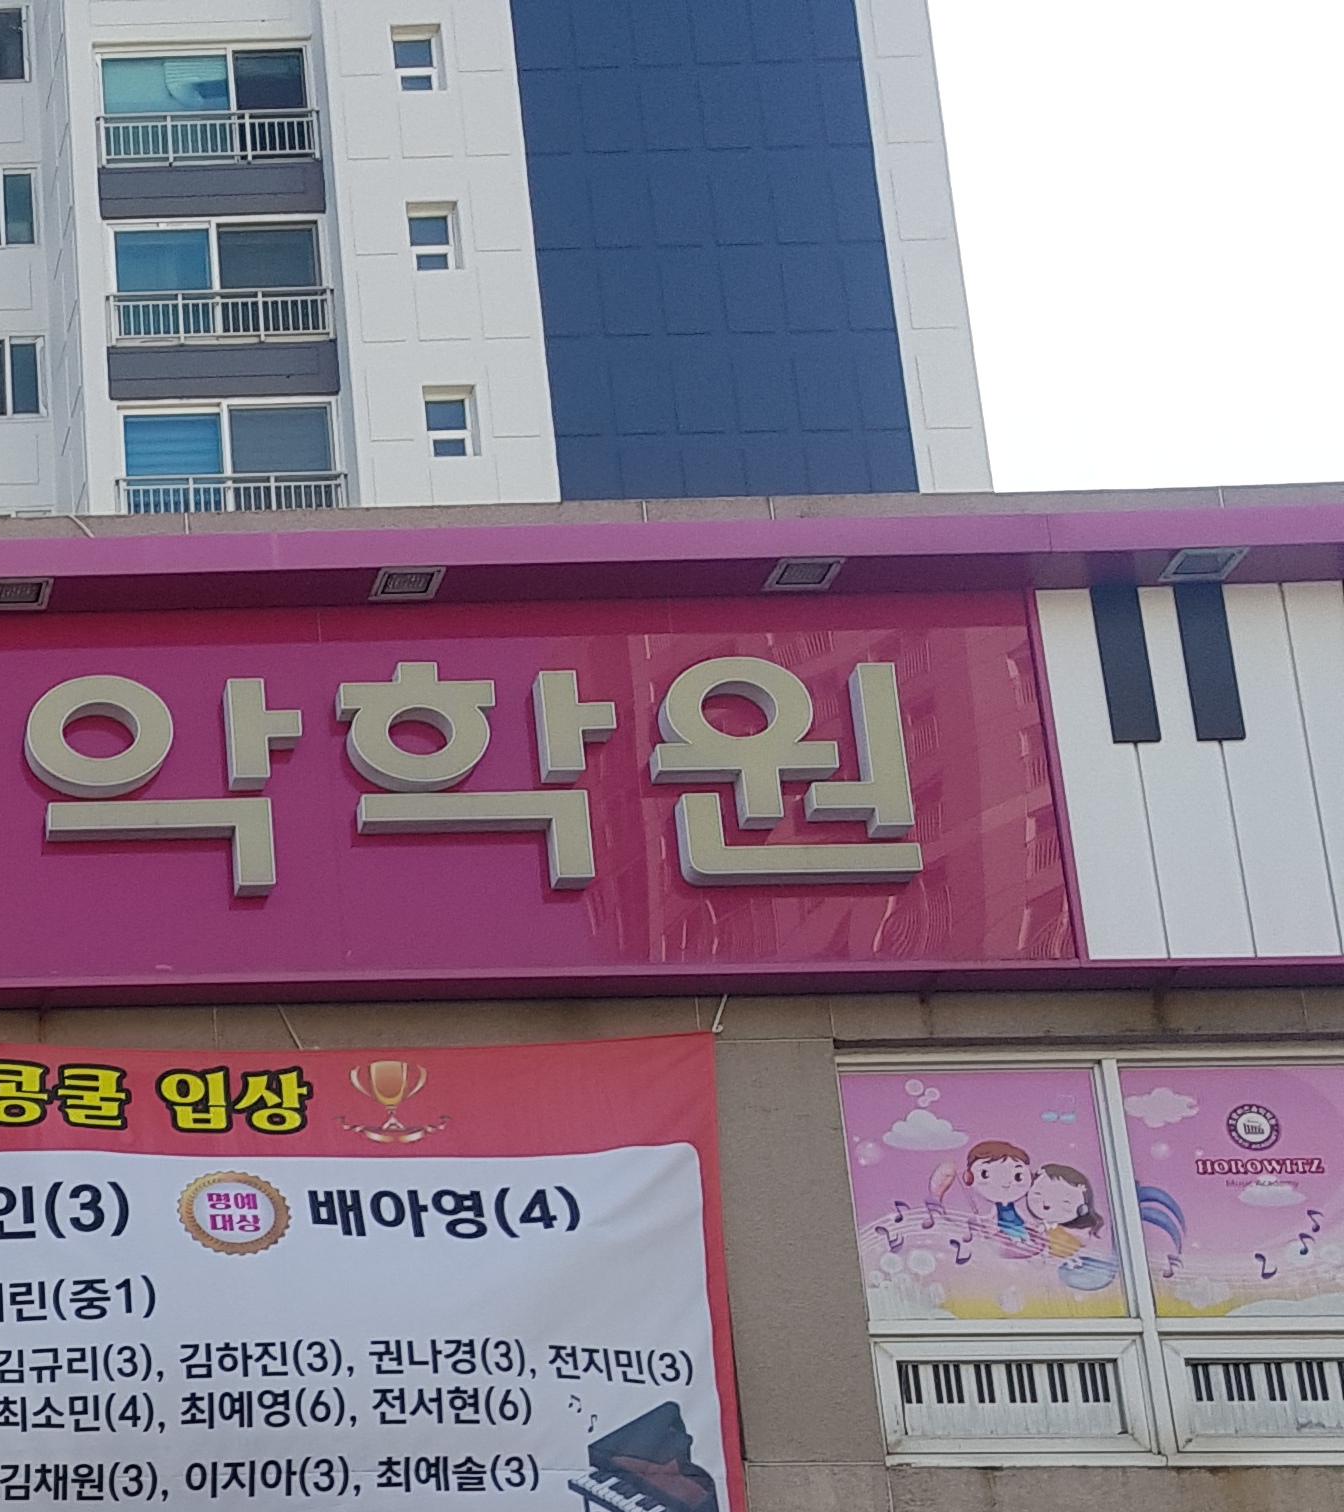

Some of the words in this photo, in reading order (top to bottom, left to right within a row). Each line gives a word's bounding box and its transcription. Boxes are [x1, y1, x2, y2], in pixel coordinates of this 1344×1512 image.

[157, 1066, 313, 1135] 입상
[1195, 1158, 1325, 1175] HOROWITZ
[206, 1192, 259, 1213] 명예
[209, 1213, 261, 1236] 대상
[310, 1184, 582, 1240] 배아영(4)
[178, 1338, 356, 1384] 김하진(3),
[367, 1337, 539, 1383] 권나경(3),
[547, 1342, 696, 1388] 전지민(3)
[179, 1385, 359, 1433] 최예영(6),
[371, 1383, 533, 1428] 전서현(6)
[183, 1456, 363, 1500] 이지아(3),
[375, 1454, 541, 1496] 최예솔(3)
